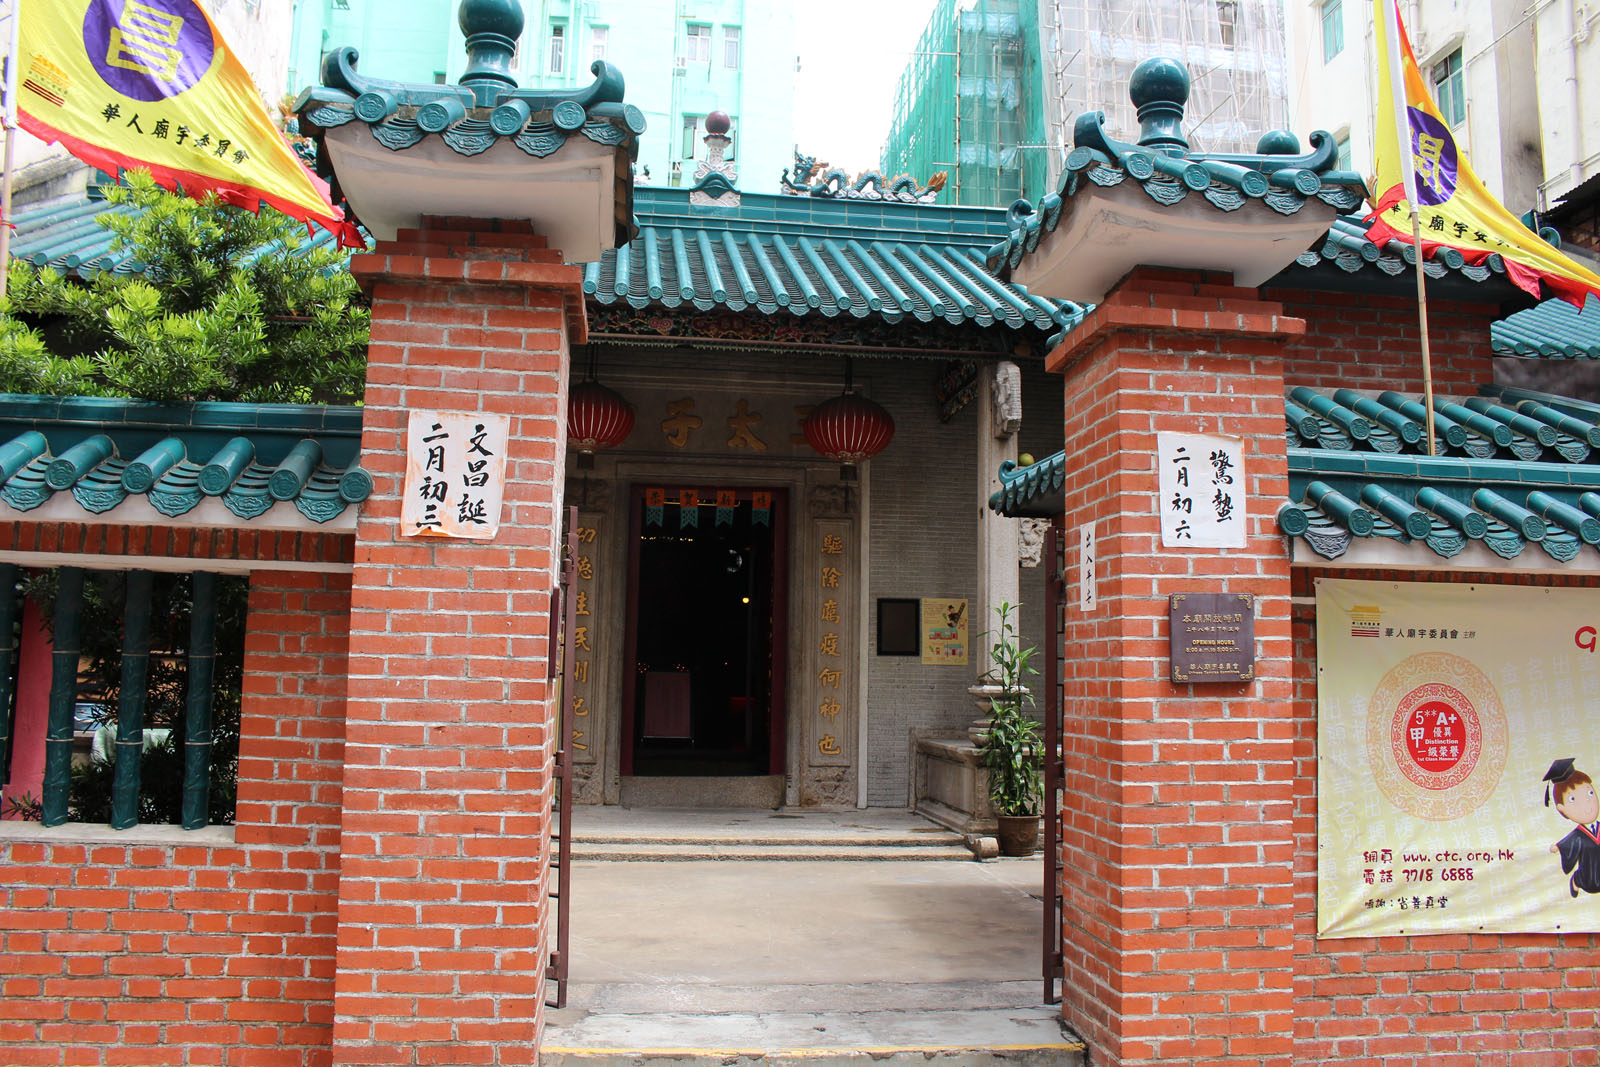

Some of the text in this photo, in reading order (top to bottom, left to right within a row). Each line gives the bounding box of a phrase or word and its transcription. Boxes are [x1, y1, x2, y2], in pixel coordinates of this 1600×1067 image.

[416, 423, 449, 529] 二月初三
[457, 424, 494, 525] 文昌誕
[1172, 447, 1193, 540] 二月初六
[1209, 449, 1234, 524] 驚蟄
[1385, 628, 1459, 640] 華人廟宇委員會
[1410, 728, 1425, 748] 甲
[1417, 746, 1459, 757] 一級榮譽
[1363, 848, 1393, 864] 網頁
[1363, 867, 1474, 885] 電話 3718 6888
